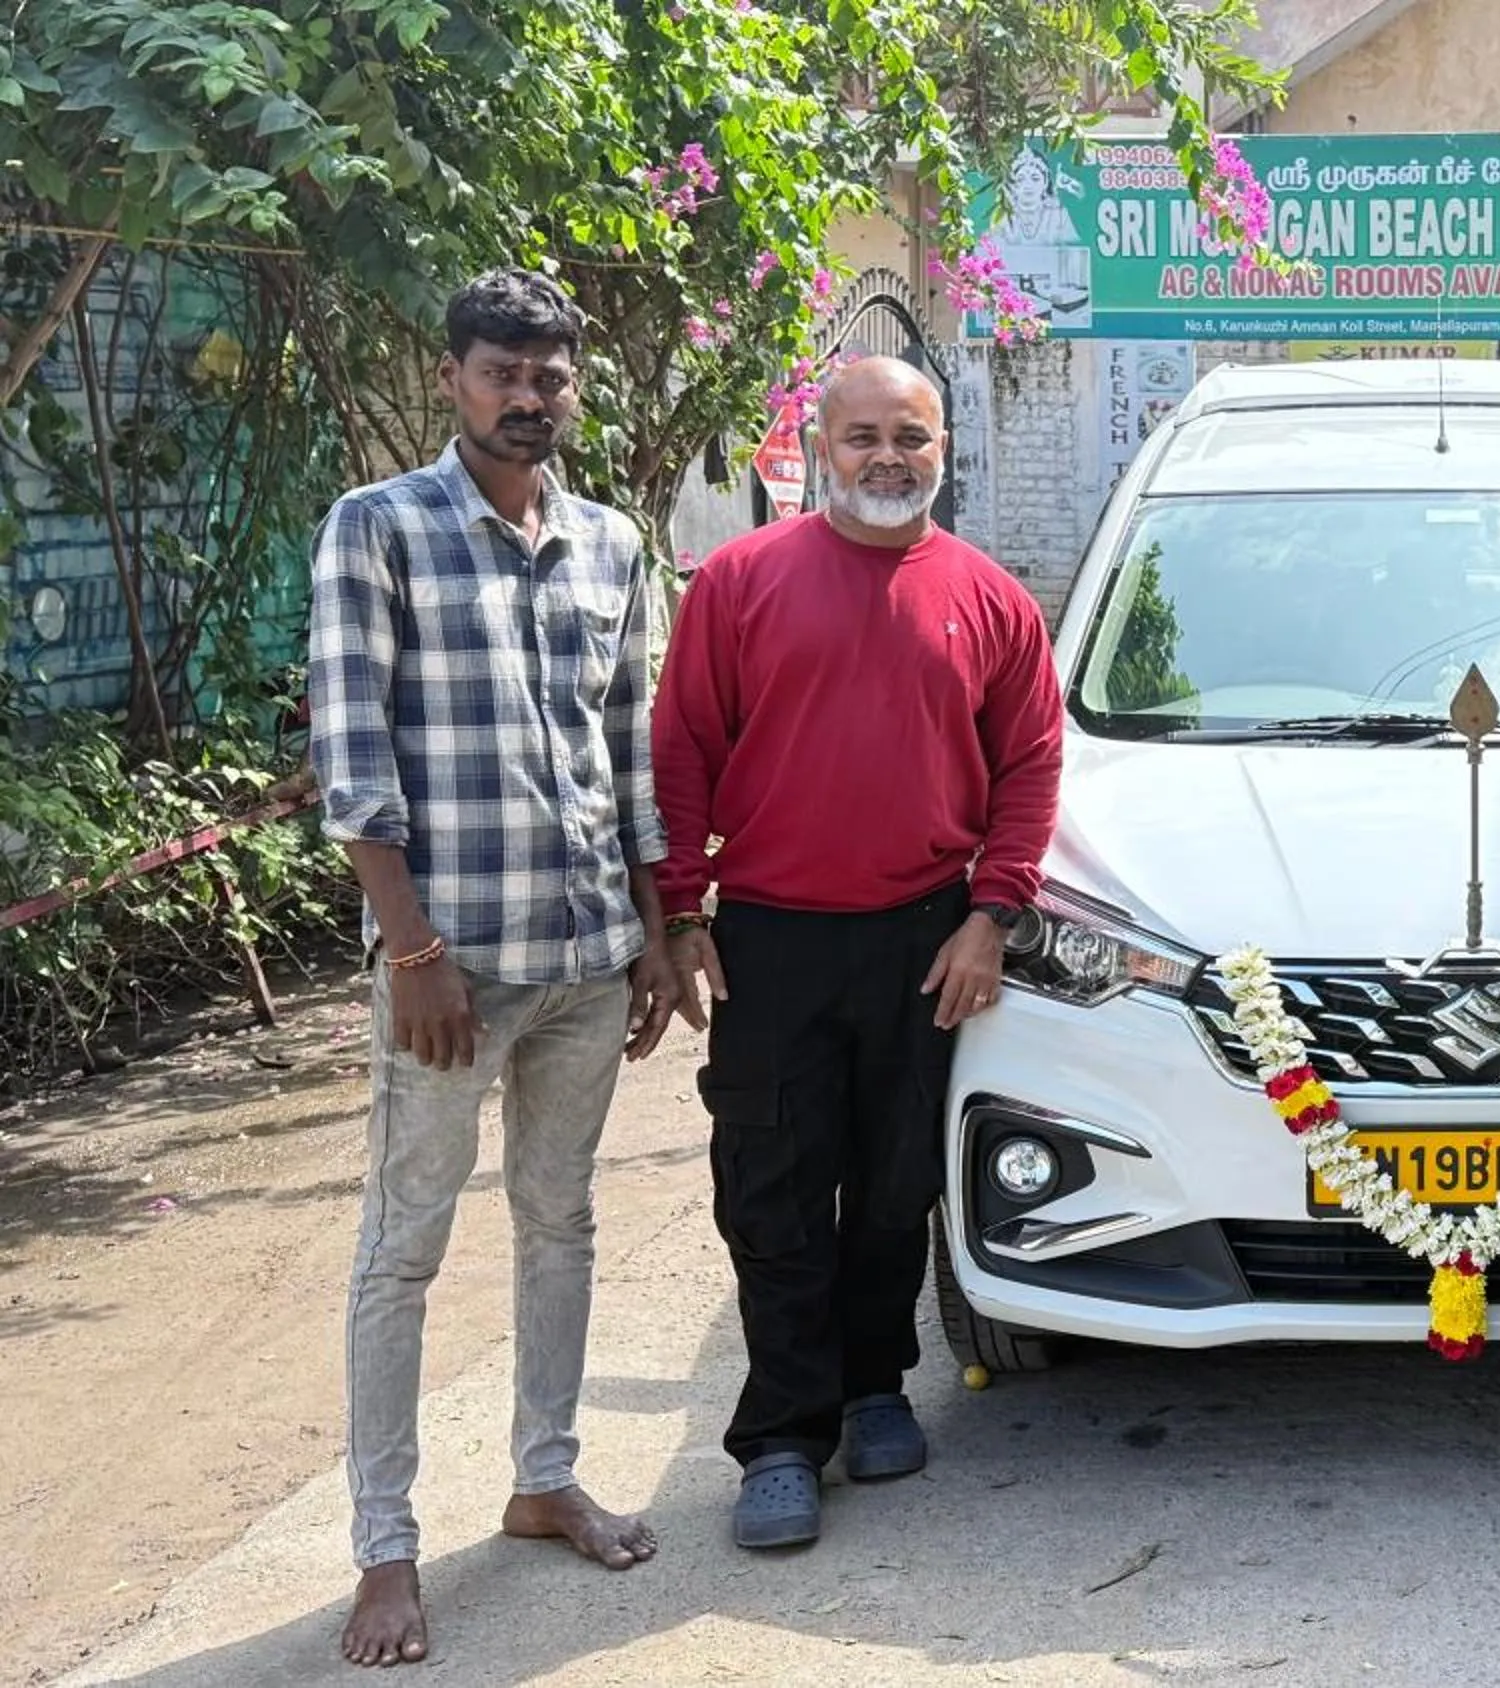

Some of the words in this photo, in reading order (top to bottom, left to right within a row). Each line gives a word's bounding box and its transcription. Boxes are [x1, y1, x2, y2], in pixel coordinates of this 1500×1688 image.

[1097, 199, 1156, 257] SRI
[1369, 197, 1493, 257] BEACH
[1159, 263, 1197, 299] AC
[1202, 263, 1225, 299] &
[1334, 263, 1444, 299] ROOMS
[1290, 319, 1337, 333] Amman
[1109, 347, 1129, 445] FRENCH
